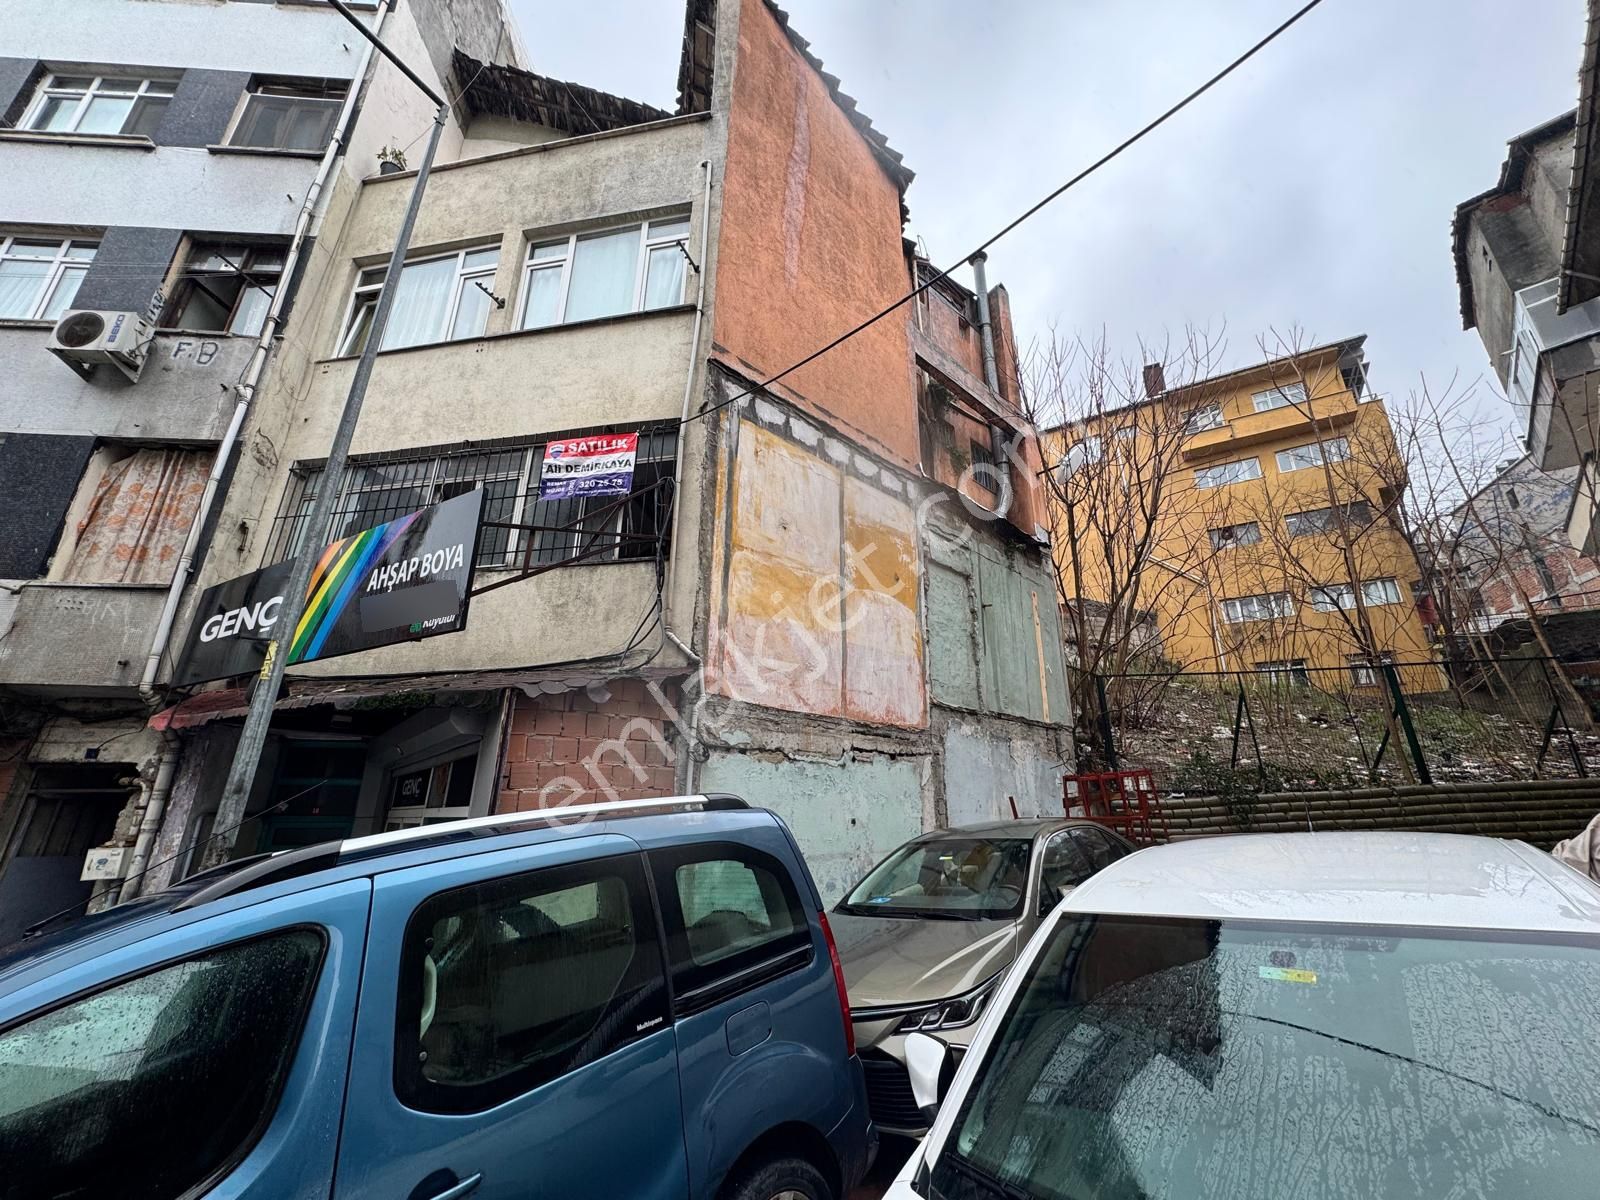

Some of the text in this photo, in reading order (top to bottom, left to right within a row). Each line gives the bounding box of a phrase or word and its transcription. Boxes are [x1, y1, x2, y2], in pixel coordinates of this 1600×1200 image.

[107, 314, 126, 343] BEKO
[567, 438, 628, 453] SATILIK
[545, 459, 632, 474] Ali DEMİRKAYA
[579, 480, 595, 488] 320
[366, 543, 464, 593] AHŞAP BOYA
[200, 595, 284, 643] GENÇ
